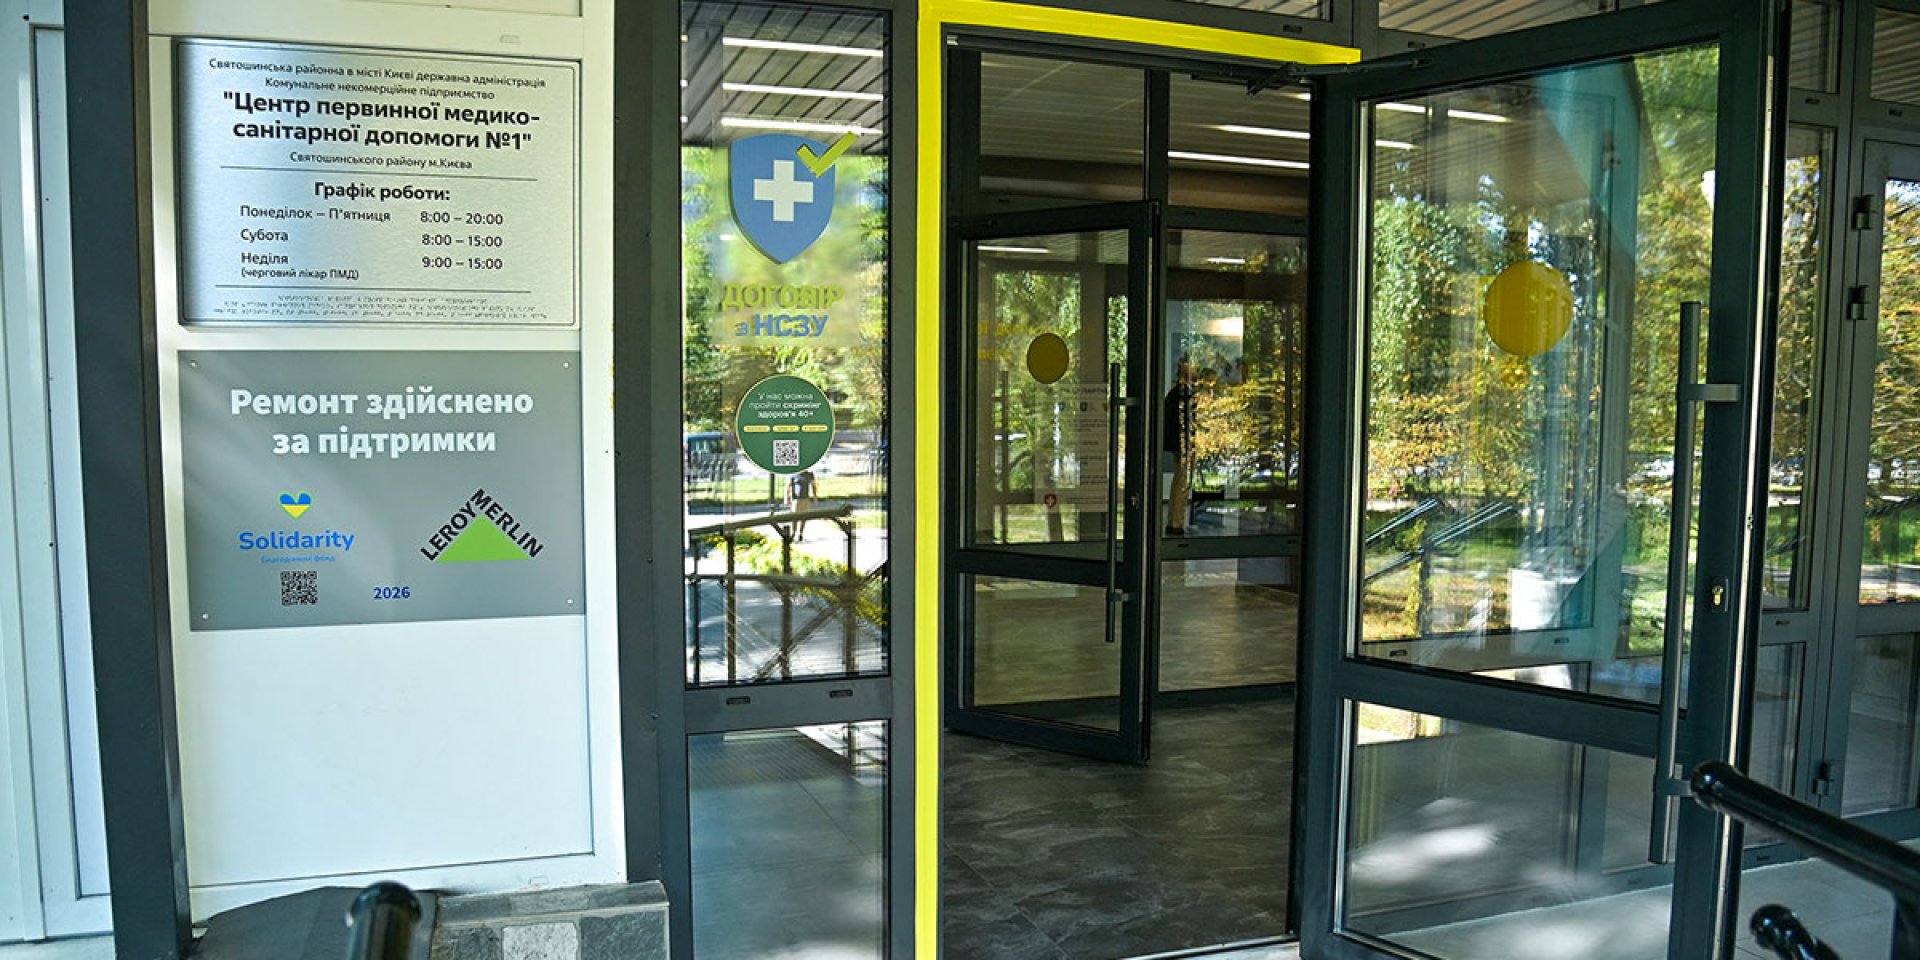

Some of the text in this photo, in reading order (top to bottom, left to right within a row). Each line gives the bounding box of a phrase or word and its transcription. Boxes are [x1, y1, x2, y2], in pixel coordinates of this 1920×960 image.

[209, 58, 546, 88] Святошинська районна в місті Києві державна адміністрація
[265, 78, 495, 100] Комунальне некомерційне підприємство
[223, 91, 540, 126] "Центр первинної медико-
[232, 120, 532, 150] санітарної допомоги №1"
[290, 151, 472, 171] Святошинського району м.Києва
[314, 181, 450, 202] Графік роботи:
[240, 204, 313, 221] Понеділок
[329, 207, 391, 223] П'ятниця
[420, 211, 450, 224] 8:00
[465, 212, 504, 225] 20:00
[240, 228, 288, 244] Субота
[421, 234, 452, 247] 8:00
[467, 235, 503, 248] 15:00
[240, 251, 289, 267] Неділя
[421, 256, 452, 269] 9:00
[467, 257, 503, 270] 15:00
[240, 267, 359, 281] (черговий лікар ПМД)
[721, 283, 844, 312] ДОГОВІР
[735, 313, 829, 337] з НСЗУ
[230, 384, 534, 421] Ремонт здійснено
[272, 424, 497, 460] за підтримки
[420, 488, 544, 562] LEROY MERLIN
[238, 529, 355, 552] Solidarity
[373, 586, 411, 600] 2026
